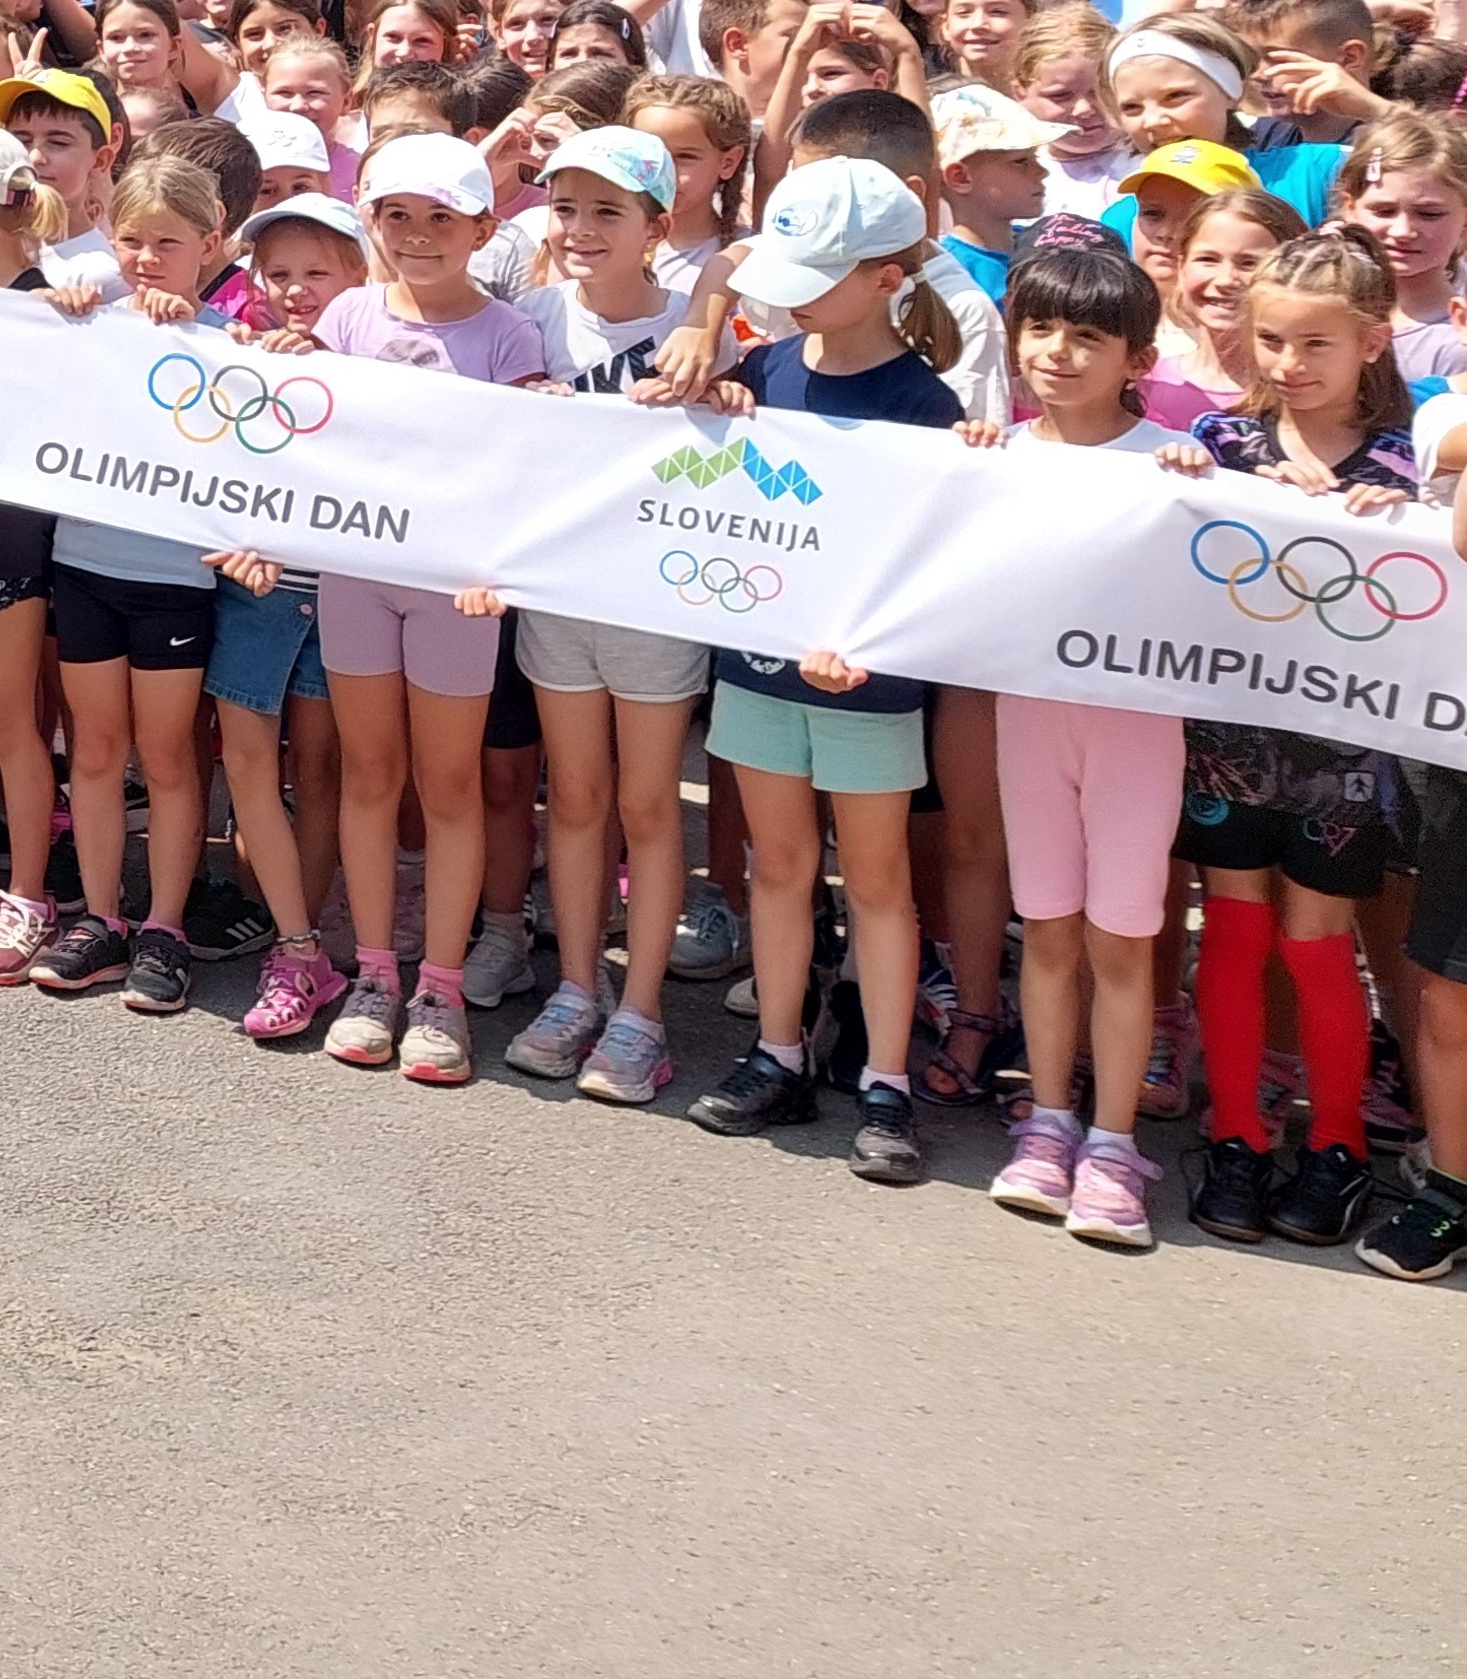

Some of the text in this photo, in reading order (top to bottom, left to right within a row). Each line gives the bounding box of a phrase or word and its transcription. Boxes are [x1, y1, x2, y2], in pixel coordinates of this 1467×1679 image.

[35, 442, 410, 543] OLIMPIJSKI DAN
[637, 499, 821, 552] SLOVENIJA
[1057, 629, 1467, 736] OLIMPIJSKI D
